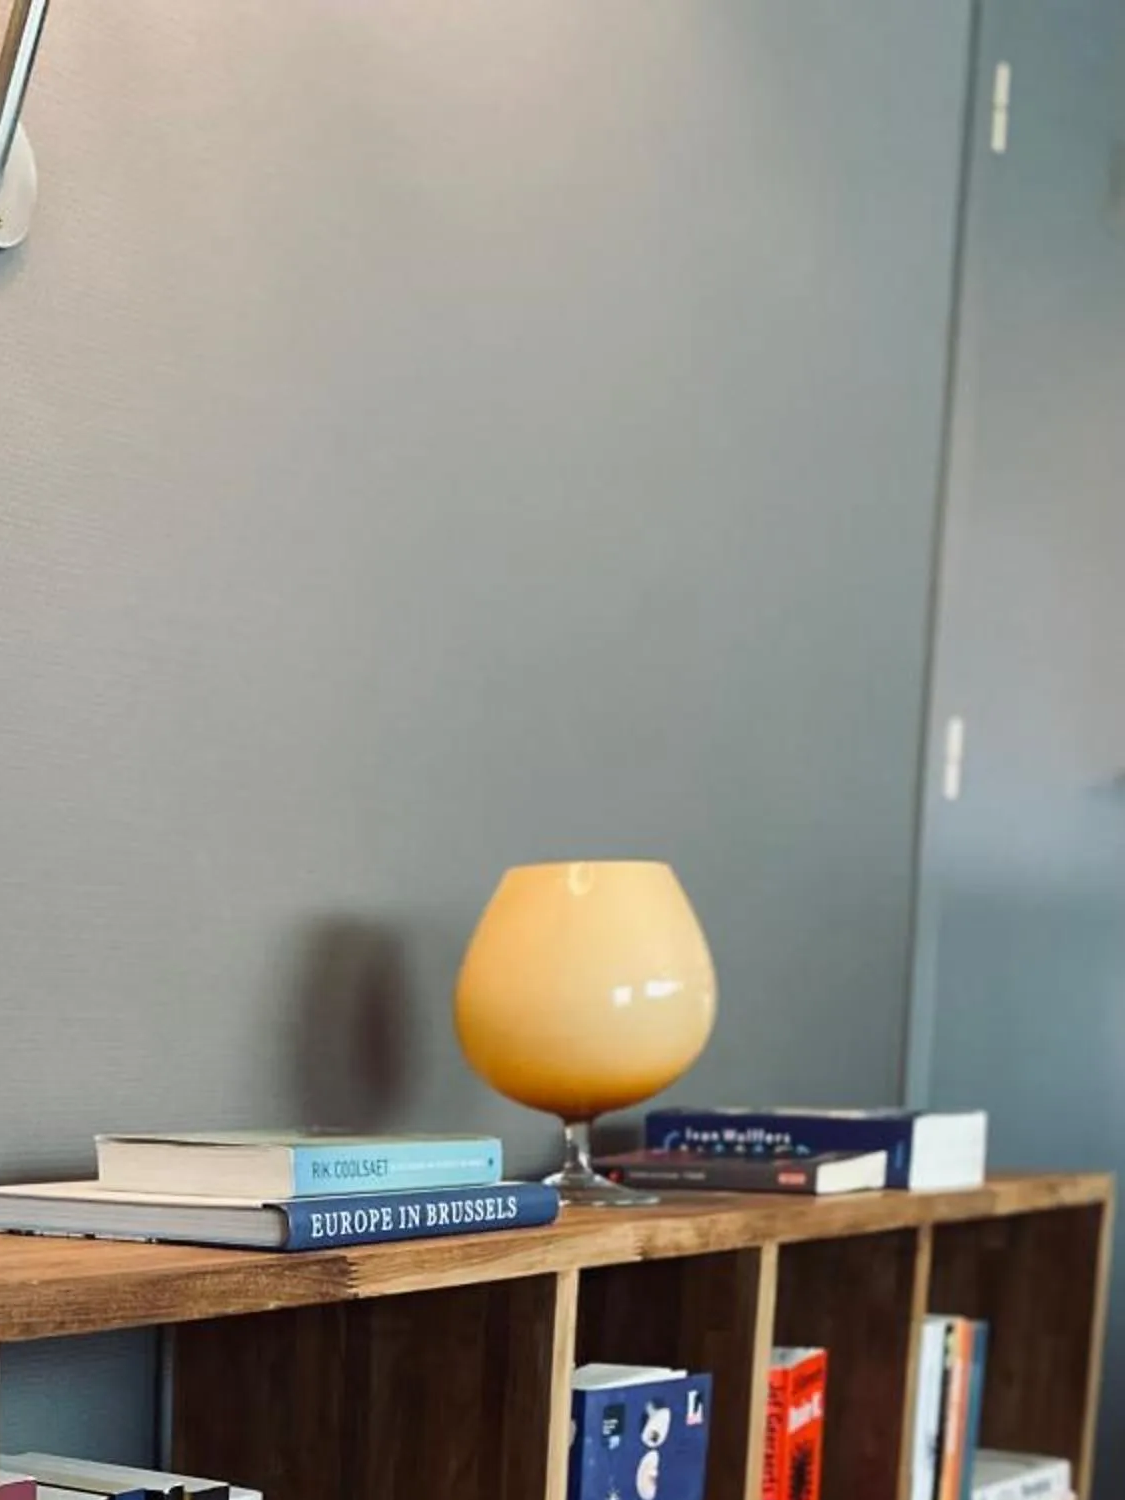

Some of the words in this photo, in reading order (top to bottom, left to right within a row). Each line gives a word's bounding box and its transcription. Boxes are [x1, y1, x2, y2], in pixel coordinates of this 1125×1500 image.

[311, 1161, 330, 1179] RIK
[334, 1159, 389, 1178] COOLSAET
[310, 1207, 393, 1238] EUROPE
[399, 1204, 421, 1230] IN
[426, 1196, 518, 1227] BRUSSELS
